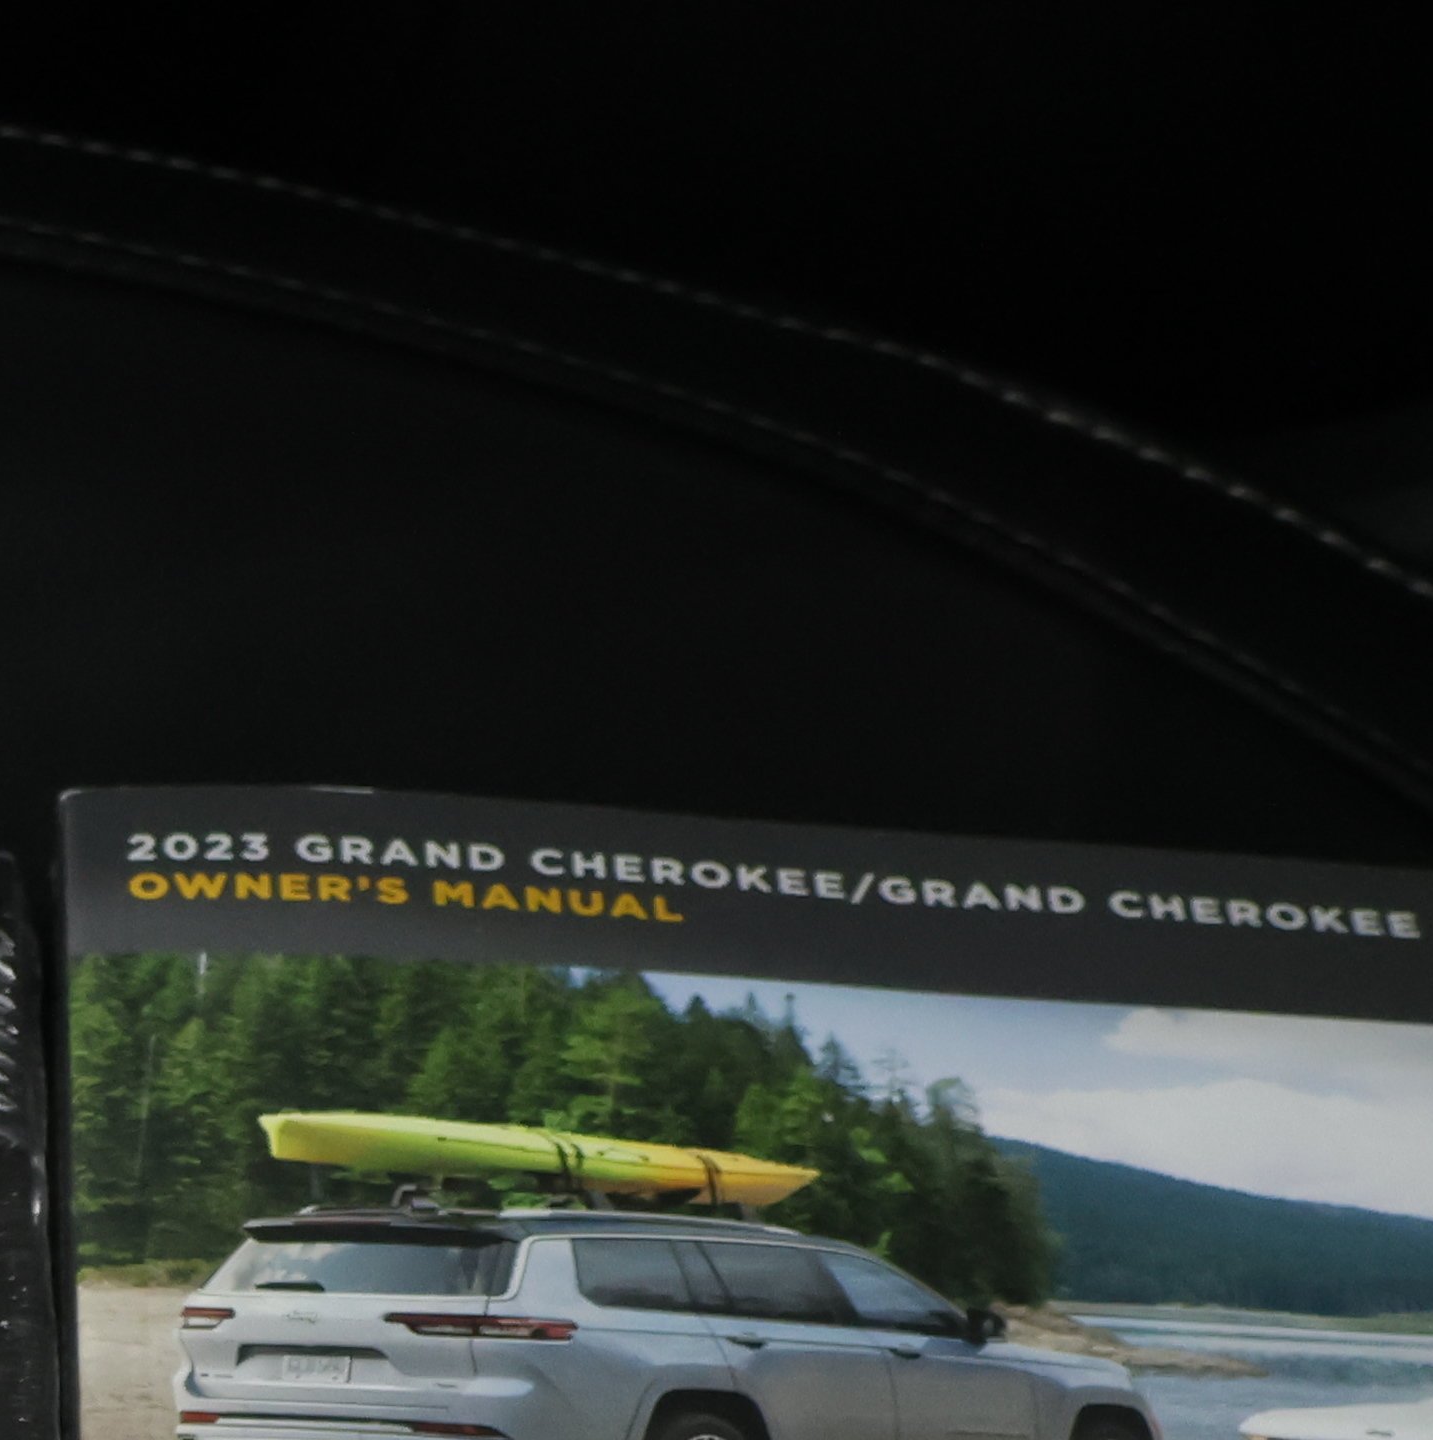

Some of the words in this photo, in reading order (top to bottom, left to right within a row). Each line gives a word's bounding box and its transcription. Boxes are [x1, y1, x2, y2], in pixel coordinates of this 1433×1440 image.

[128, 833, 270, 862] 2023
[296, 834, 505, 873] GRAND
[531, 848, 1085, 914] CHEROKEE/GRAND
[1108, 890, 1421, 941] CHEROKEE
[128, 872, 409, 906] OWNER'S
[434, 881, 684, 923] MANUAL
